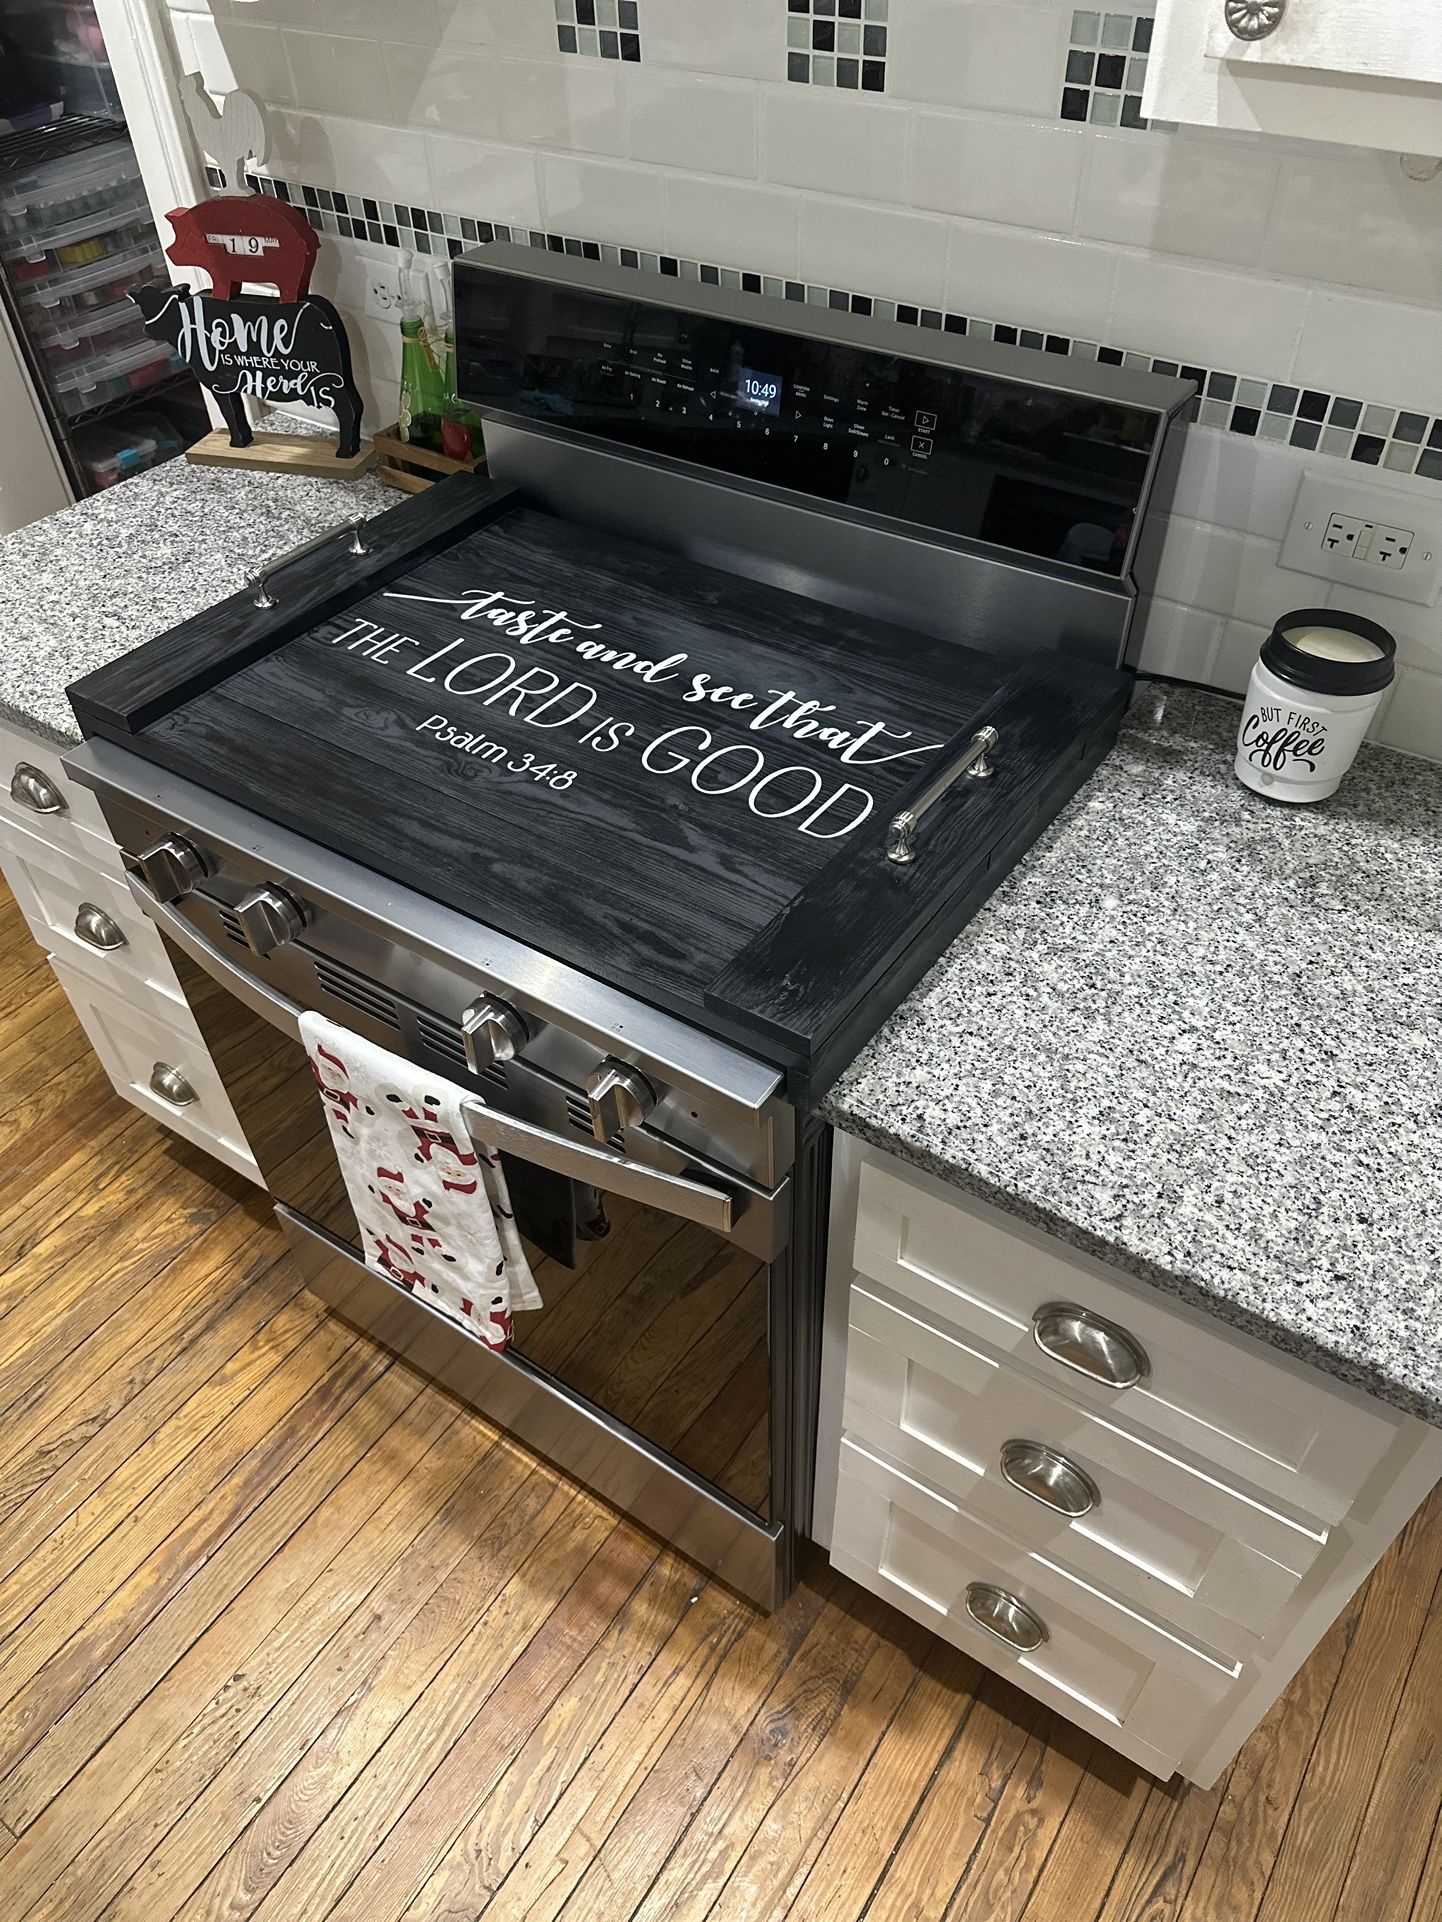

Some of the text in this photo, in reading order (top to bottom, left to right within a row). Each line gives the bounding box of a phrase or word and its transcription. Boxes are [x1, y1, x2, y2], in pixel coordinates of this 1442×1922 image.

[220, 353, 320, 373] IS WHERE YOUR
[222, 370, 327, 399] Herd
[310, 386, 335, 408] IS
[745, 379, 777, 399] 10:49
[396, 588, 945, 765] taste and see that
[331, 618, 874, 839] THE LORD IS GOOD
[1260, 705, 1328, 736] BUT FIRST
[415, 714, 578, 791] Psalm 34:8
[1242, 714, 1325, 772] Coffee
